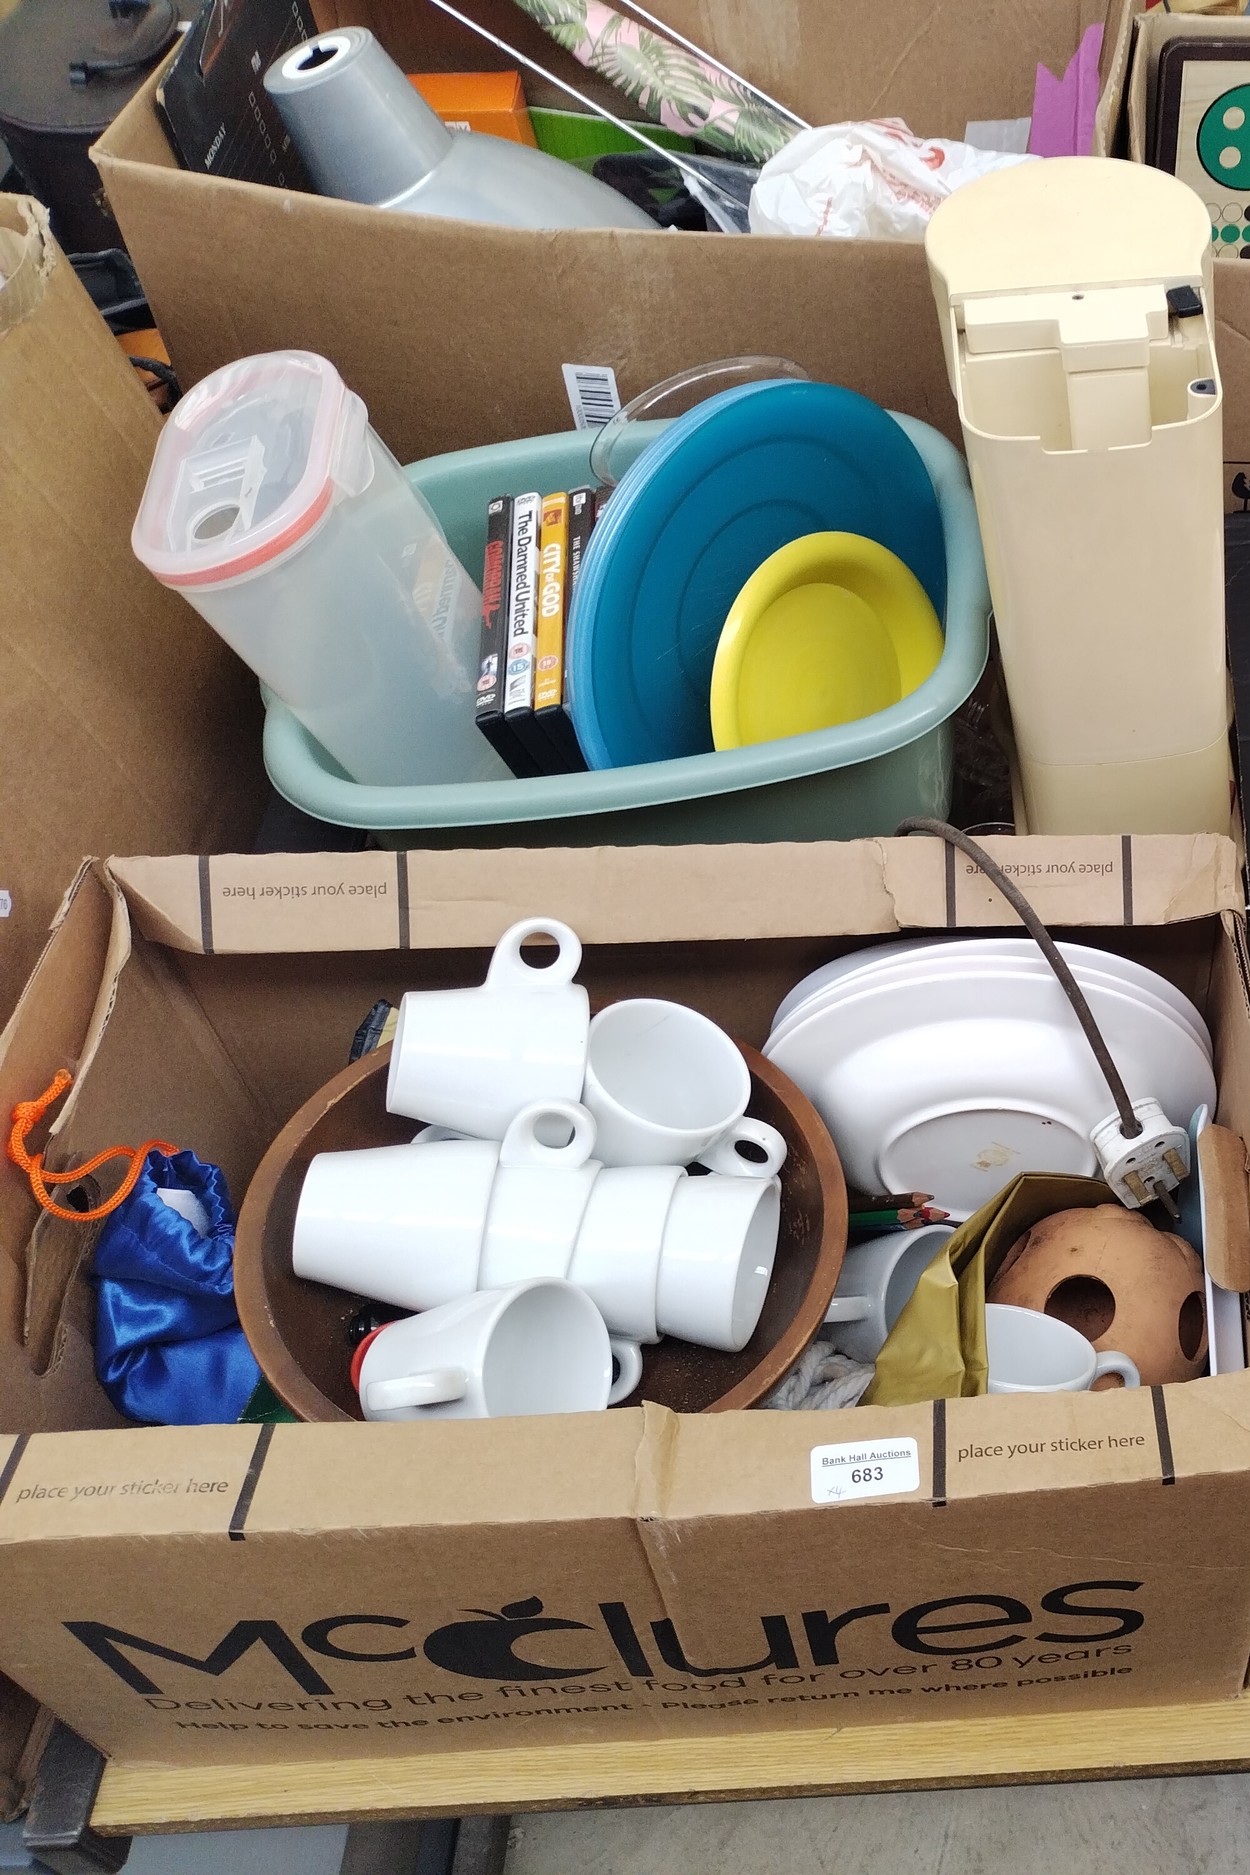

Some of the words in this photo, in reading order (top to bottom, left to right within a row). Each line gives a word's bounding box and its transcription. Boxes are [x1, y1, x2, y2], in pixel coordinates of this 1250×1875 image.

[204, 122, 227, 170] MONDAY
[518, 510, 533, 538] The
[572, 536, 581, 553] THE
[515, 536, 532, 590] Damned
[542, 543, 561, 575] CITY
[541, 581, 560, 618] GOD
[513, 589, 530, 638] United
[1045, 861, 1075, 874] your
[1079, 862, 1113, 876] place
[222, 886, 256, 900] here
[259, 886, 308, 900] sticker
[311, 882, 345, 896] your
[348, 882, 387, 898] place
[822, 1456, 847, 1466] Bank
[849, 1452, 867, 1462] Hall
[869, 1449, 912, 1460] Auctions
[958, 1443, 1003, 1462] place
[1007, 1442, 1046, 1459] your
[1050, 1437, 1103, 1452] sticker
[1108, 1435, 1146, 1448] here
[851, 1466, 884, 1484] 683
[16, 1484, 70, 1503] place
[70, 1484, 115, 1502] your
[185, 1478, 229, 1494] here
[144, 1696, 394, 1712] Delivering
[402, 1689, 485, 1706] the
[494, 1679, 635, 1698] finest
[641, 1675, 748, 1692] food
[761, 1671, 827, 1687] for
[839, 1662, 939, 1680] over
[950, 1655, 1004, 1672] 80
[1011, 1643, 1133, 1669] years
[174, 1719, 249, 1731] Help
[255, 1721, 292, 1731] to
[297, 1721, 370, 1731] save
[377, 1717, 428, 1729] the
[437, 1701, 634, 1725] environment
[661, 1697, 759, 1710] Please
[767, 1690, 860, 1704] return
[868, 1685, 913, 1696] me
[920, 1680, 1009, 1694] where
[1016, 1665, 1134, 1688] possible
